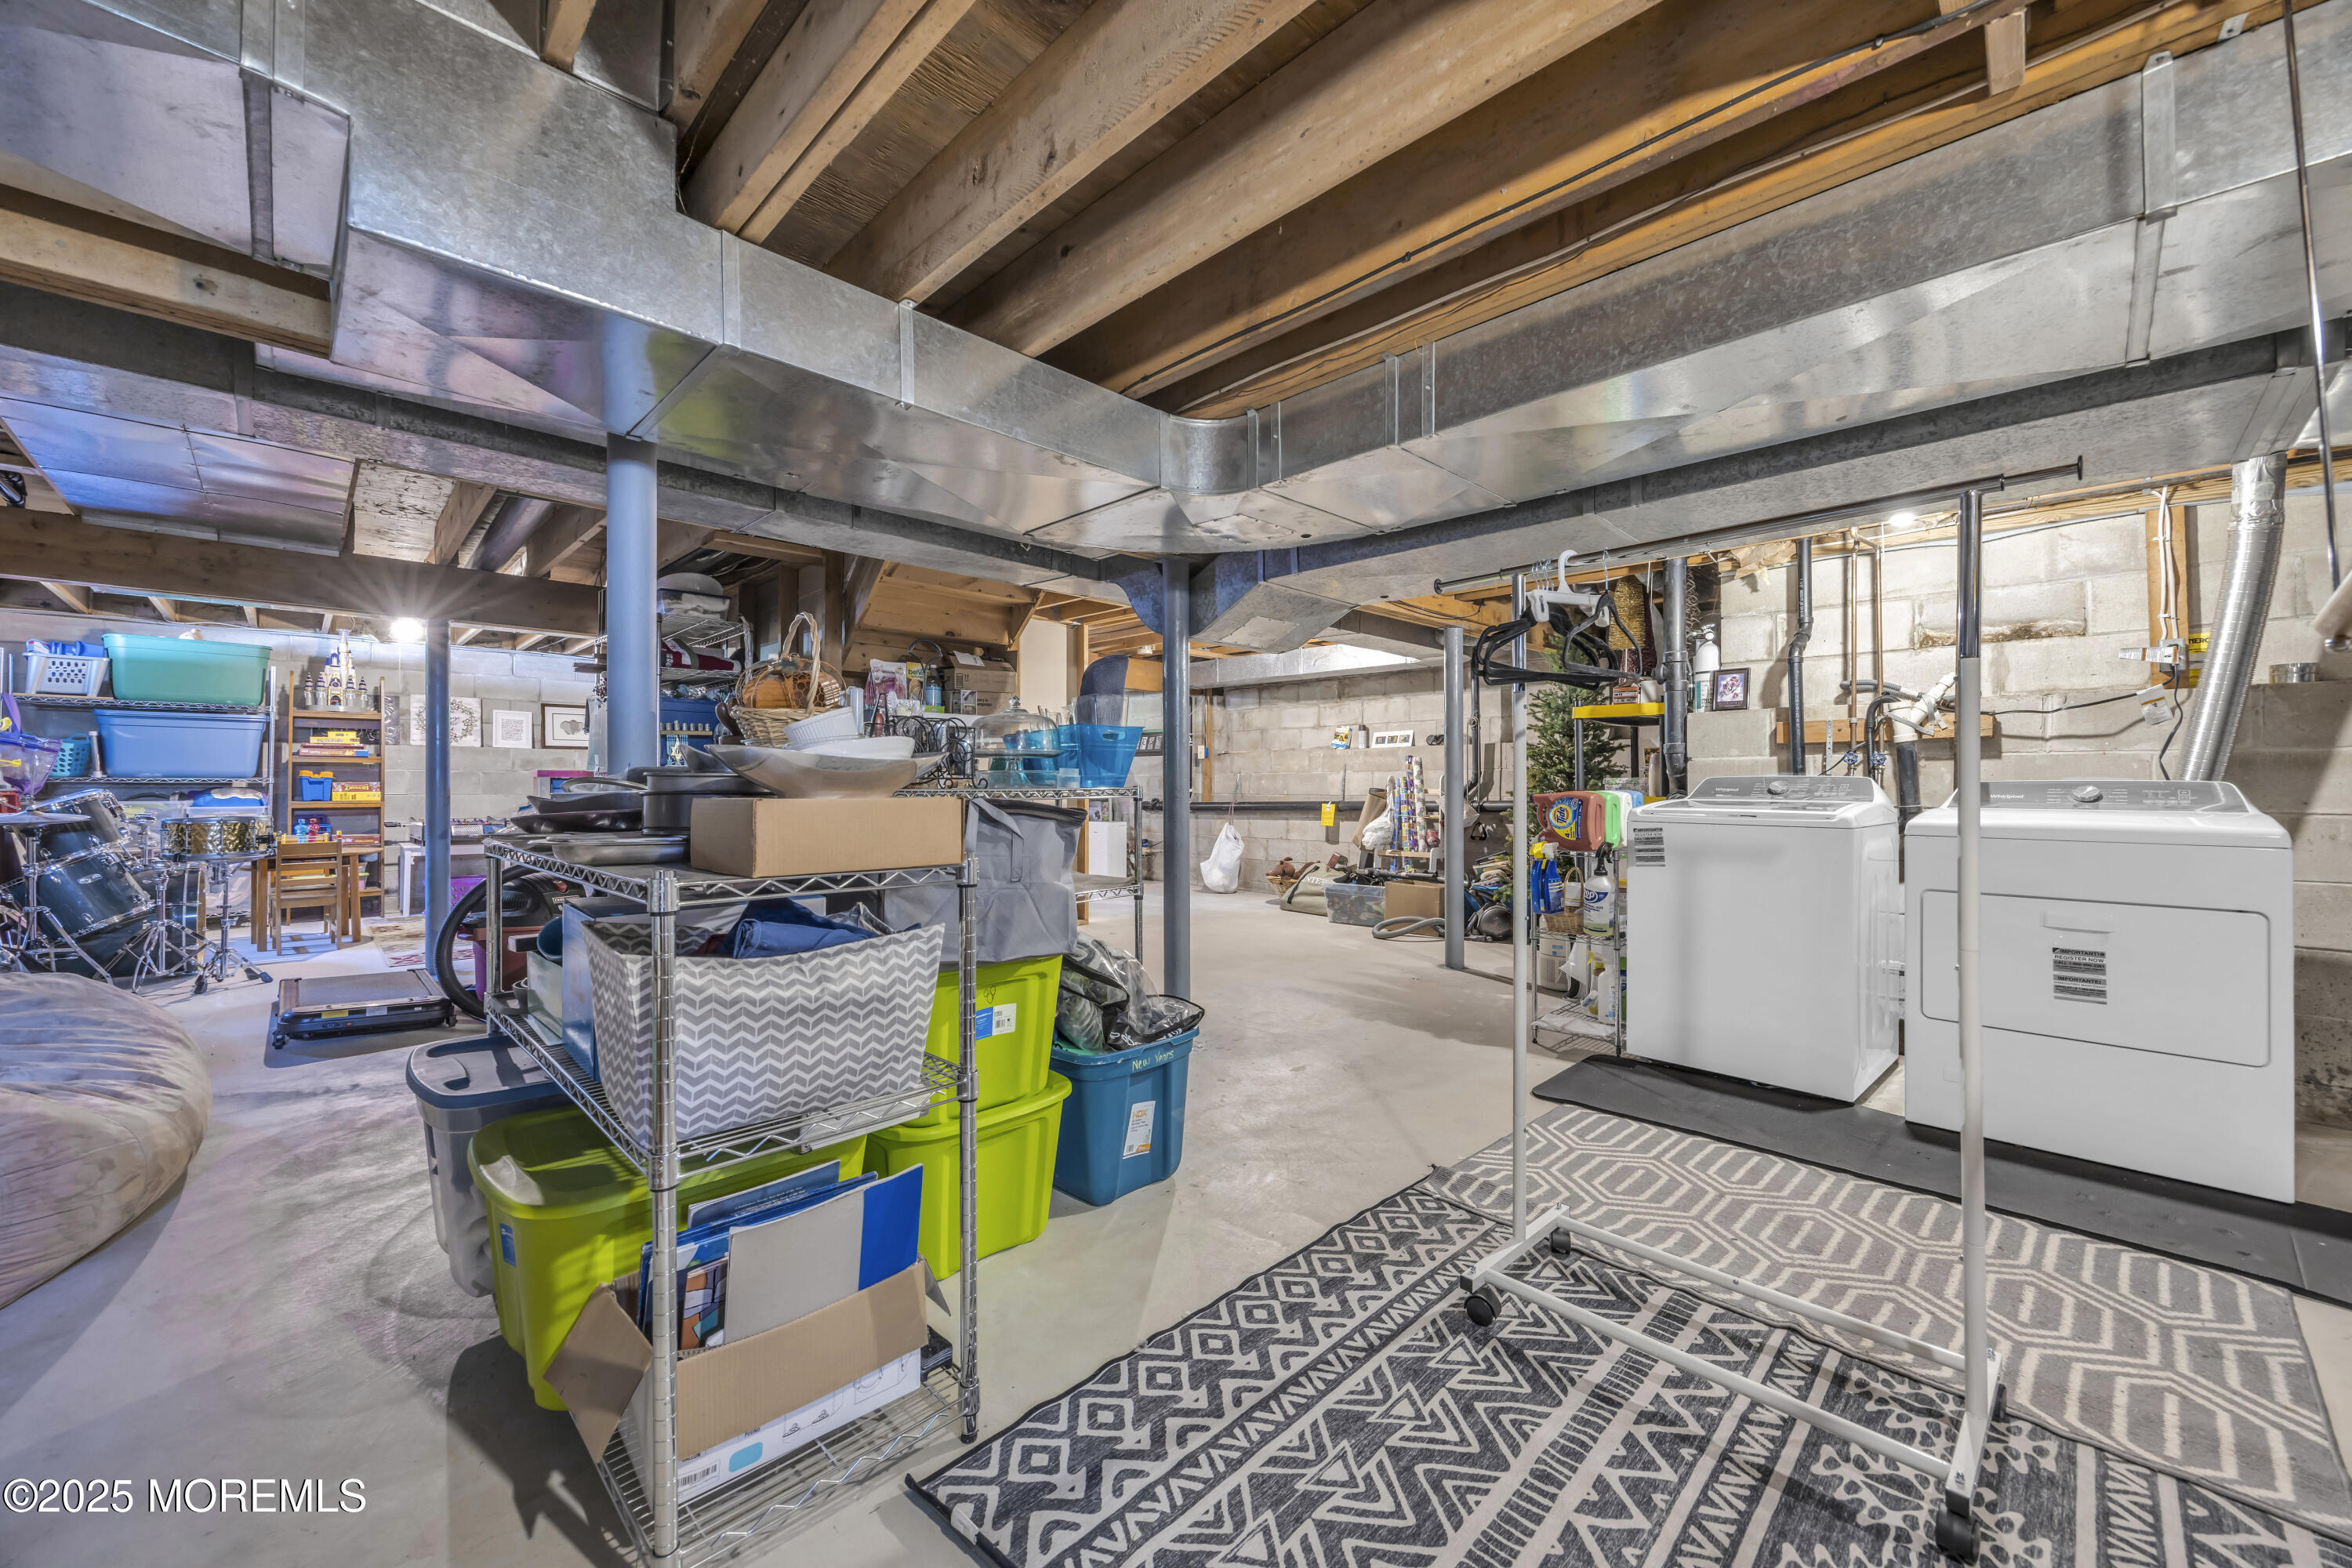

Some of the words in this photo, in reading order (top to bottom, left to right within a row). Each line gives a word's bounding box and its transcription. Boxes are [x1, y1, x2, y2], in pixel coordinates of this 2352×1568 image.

[1556, 806, 1567, 823] Tide
[1132, 1057, 1151, 1073] New
[1155, 1050, 1174, 1064] Years
[1132, 1109, 1148, 1119] HDX
